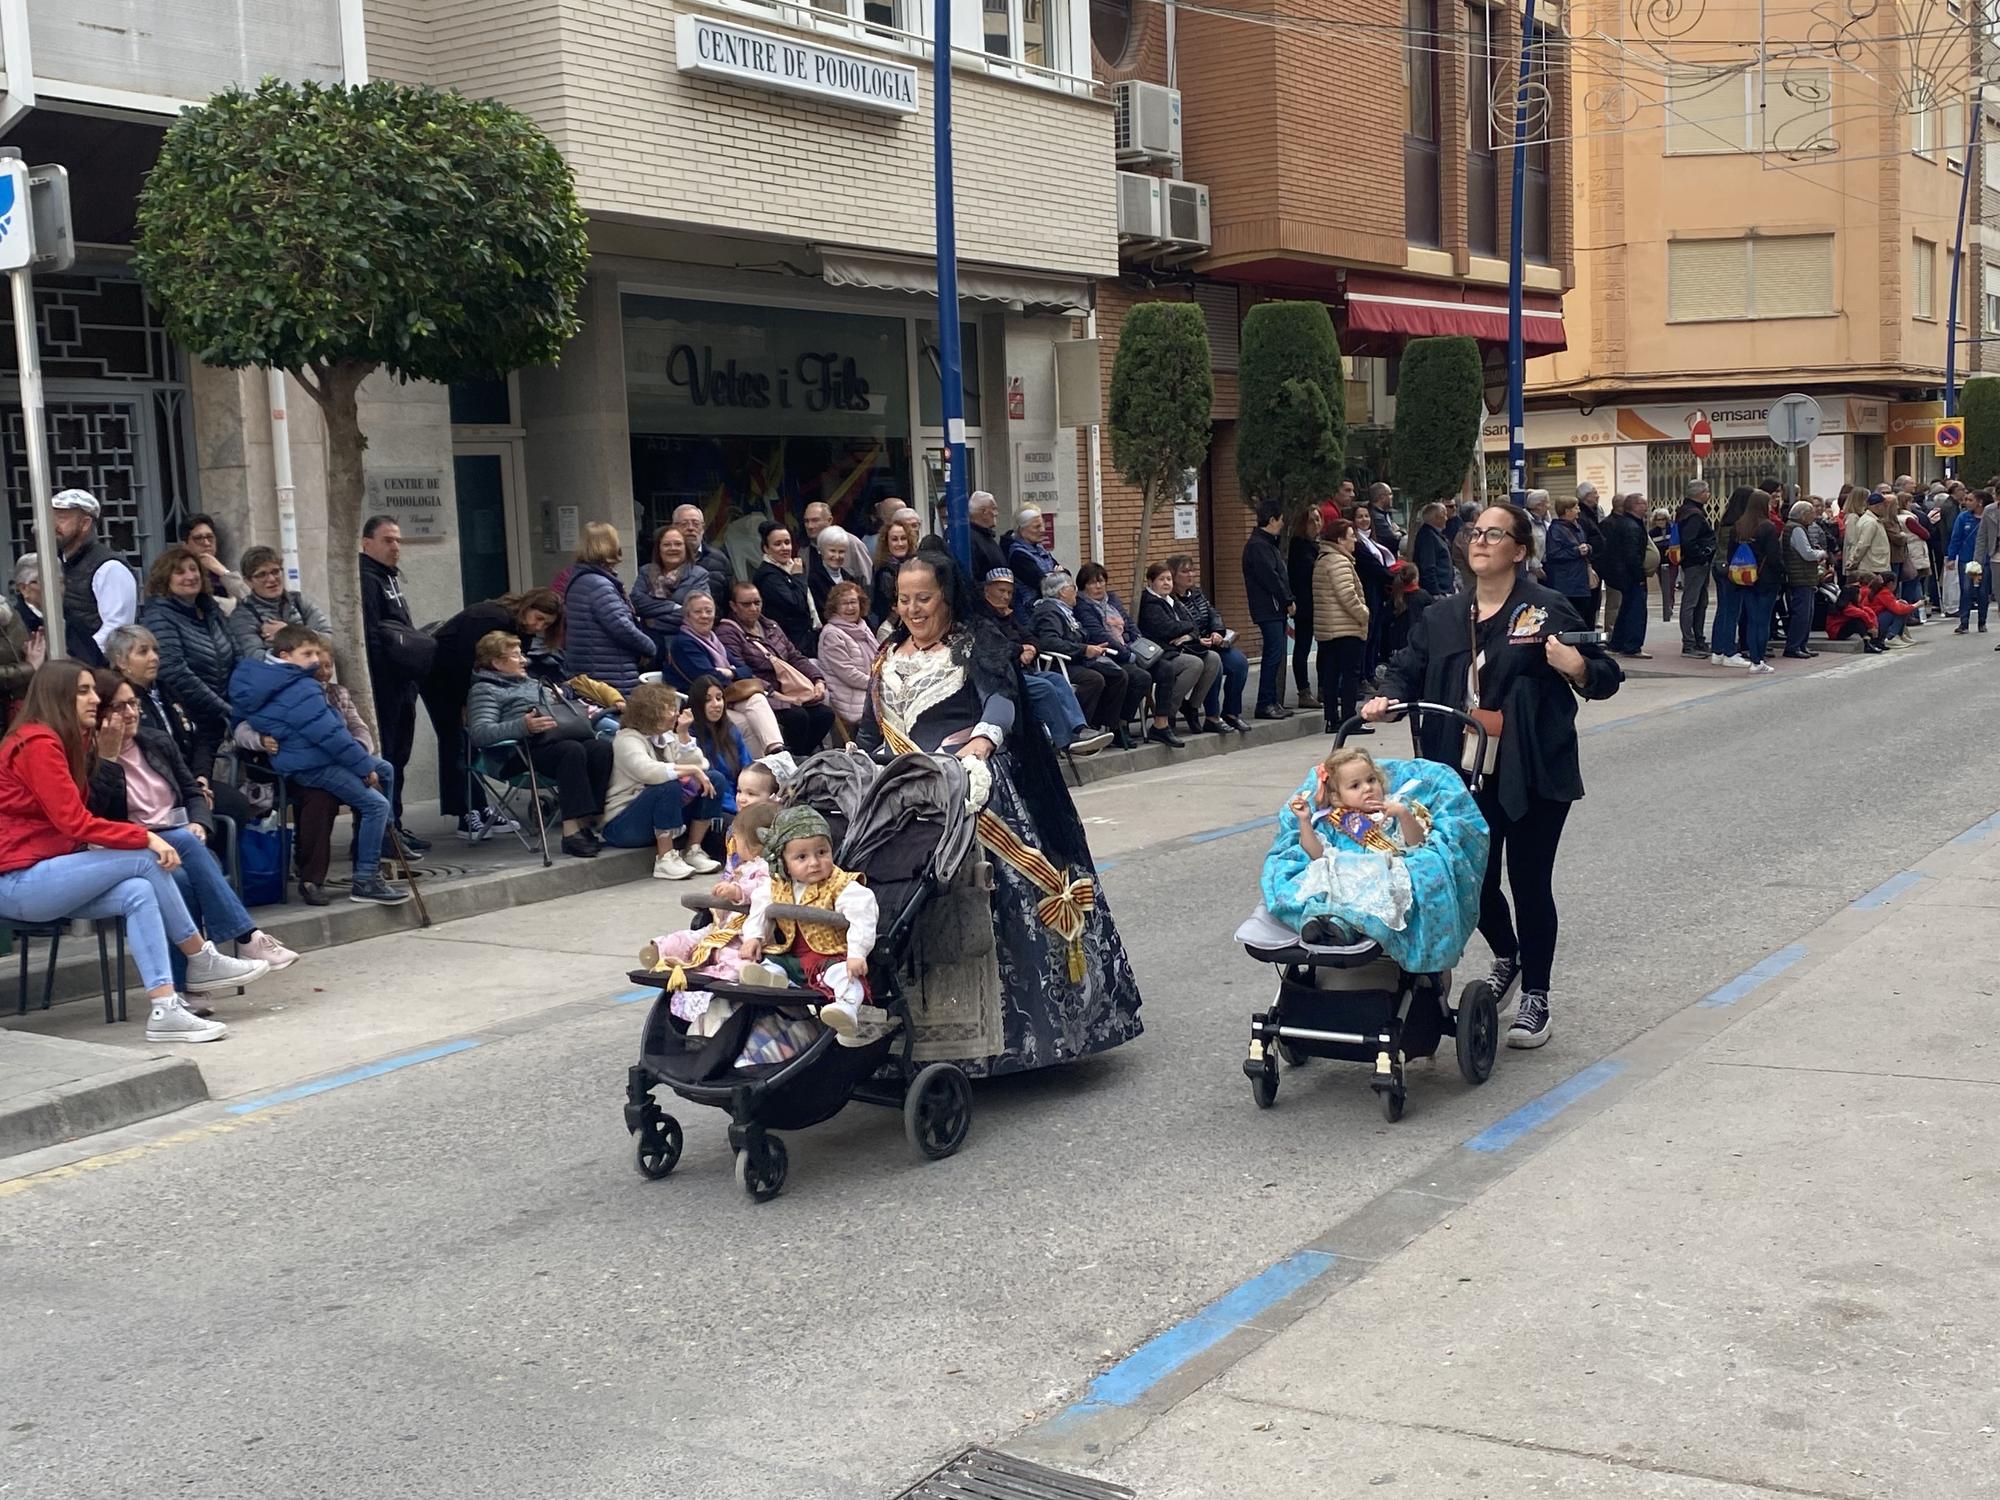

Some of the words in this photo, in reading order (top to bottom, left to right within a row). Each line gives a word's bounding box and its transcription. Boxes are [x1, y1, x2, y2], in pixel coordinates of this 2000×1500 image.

[699, 28, 777, 73] CENTRE
[783, 46, 807, 80] DE
[815, 54, 912, 103] PODOLOGIA
[666, 344, 770, 409] Vetes
[778, 369, 792, 409] i
[797, 352, 870, 412] Fils
[1711, 409, 1769, 422] emsane
[384, 478, 424, 490] CENTRE
[427, 478, 440, 490] DE
[386, 496, 442, 507] PODOLOGIA
